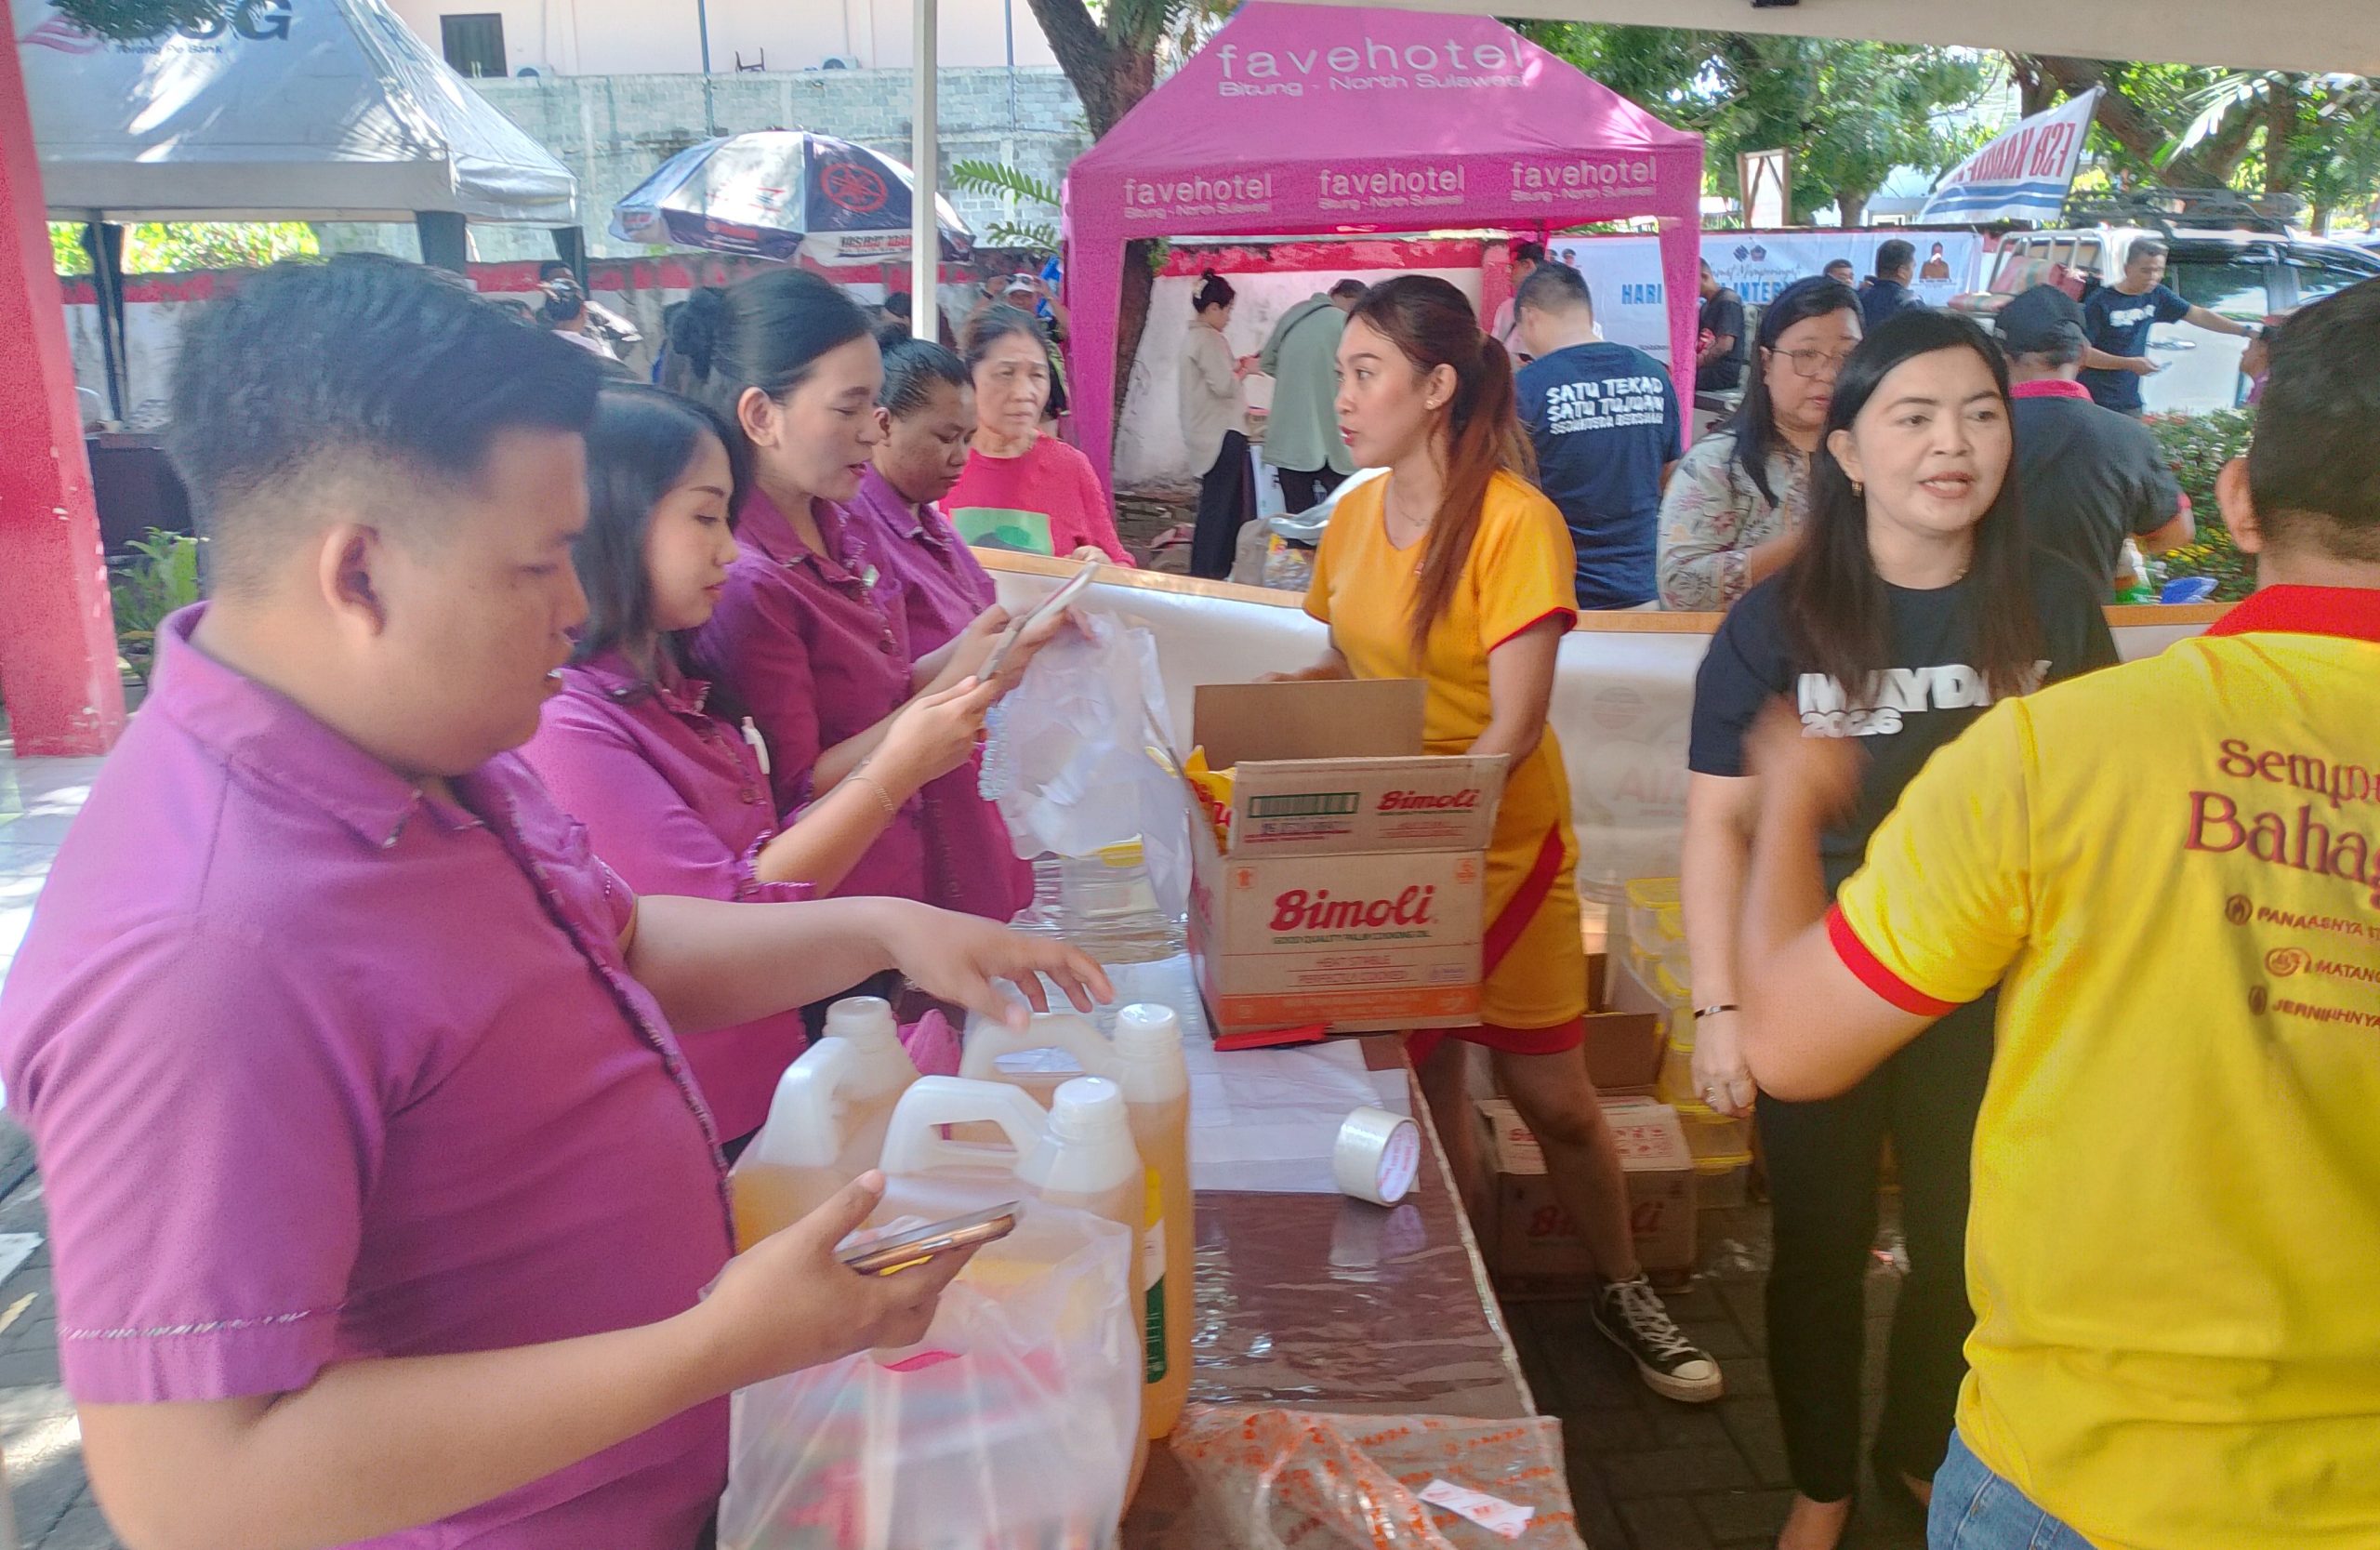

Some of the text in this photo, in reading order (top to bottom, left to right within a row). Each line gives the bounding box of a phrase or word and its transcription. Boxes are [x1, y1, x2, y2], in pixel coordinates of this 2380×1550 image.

[1216, 36, 1525, 78] favehotel
[1219, 81, 1303, 97] Bitung
[1329, 74, 1408, 90] North
[1317, 164, 1465, 196] favehotel
[1511, 155, 1657, 189] favehotel
[1124, 173, 1272, 205] favehotel
[1545, 376, 1664, 405] SATU TEKAD
[1546, 400, 1596, 423] SATU
[1376, 788, 1481, 812] Bimoli
[1269, 884, 1437, 932] Bimoli
